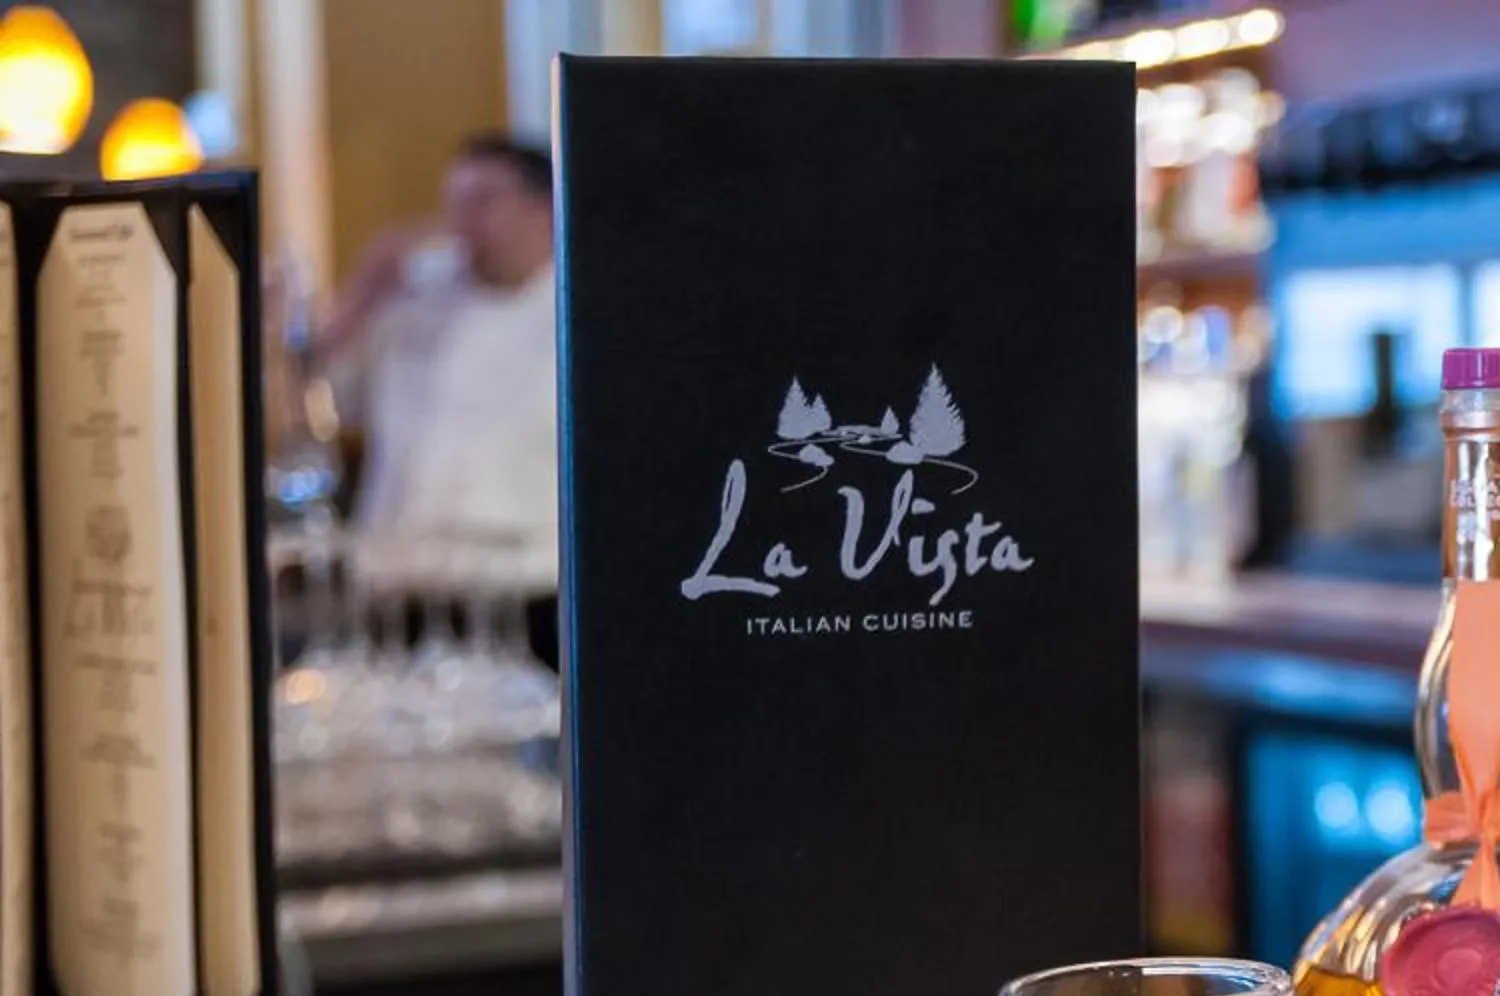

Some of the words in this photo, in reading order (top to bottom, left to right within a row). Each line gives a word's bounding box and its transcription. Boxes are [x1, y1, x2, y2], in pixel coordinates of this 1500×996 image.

[681, 458, 808, 600] La
[837, 468, 1035, 606] Vista
[746, 616, 851, 636] ITALIAN
[862, 610, 974, 632] CUISINE
